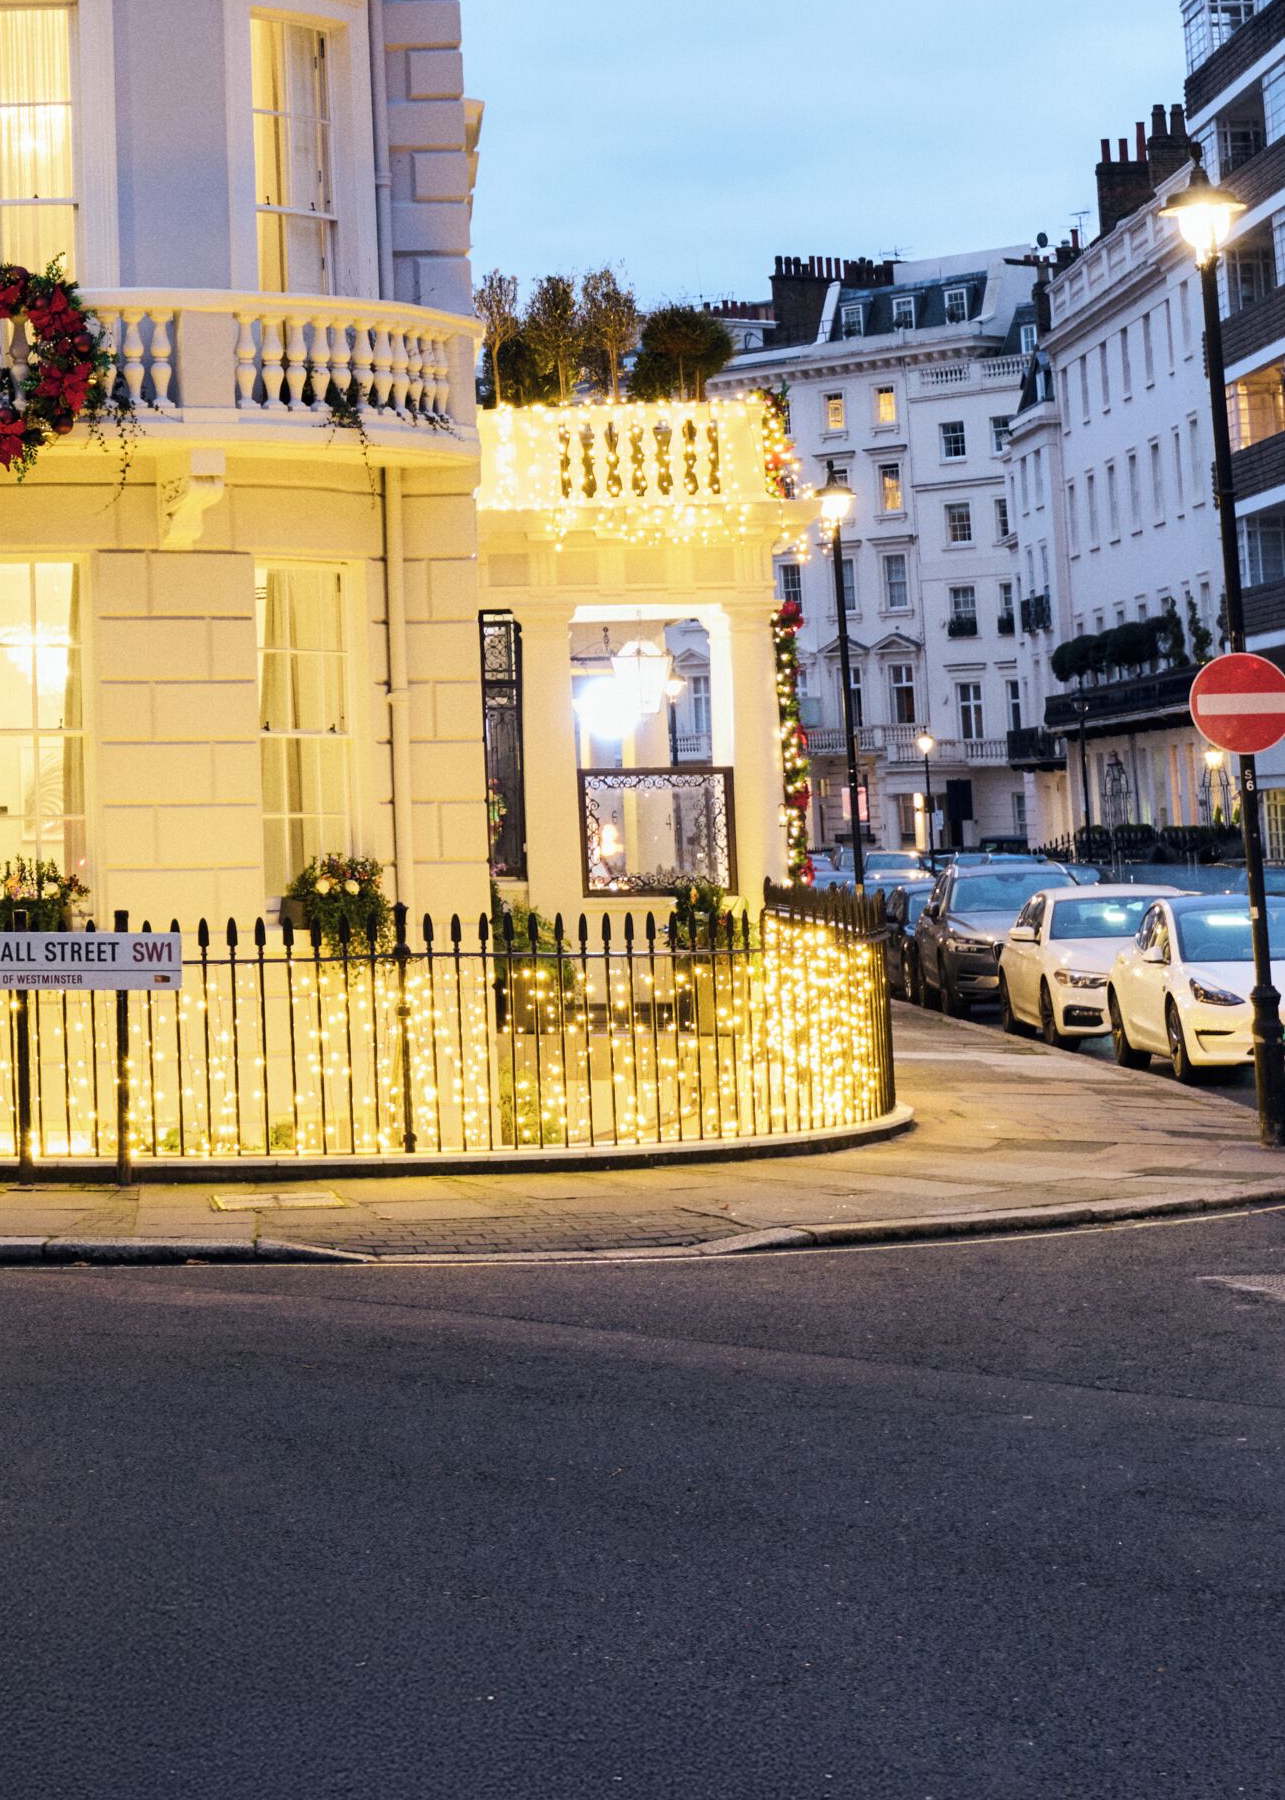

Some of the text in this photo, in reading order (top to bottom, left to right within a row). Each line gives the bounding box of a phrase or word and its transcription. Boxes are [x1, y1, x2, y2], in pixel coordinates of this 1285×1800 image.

[1244, 769, 1253, 779] S
[1246, 780, 1254, 791] 6
[44, 941, 119, 962] STREET
[132, 942, 173, 963] SW1
[2, 975, 13, 984] OF
[17, 975, 83, 984] WESTMINSTER
